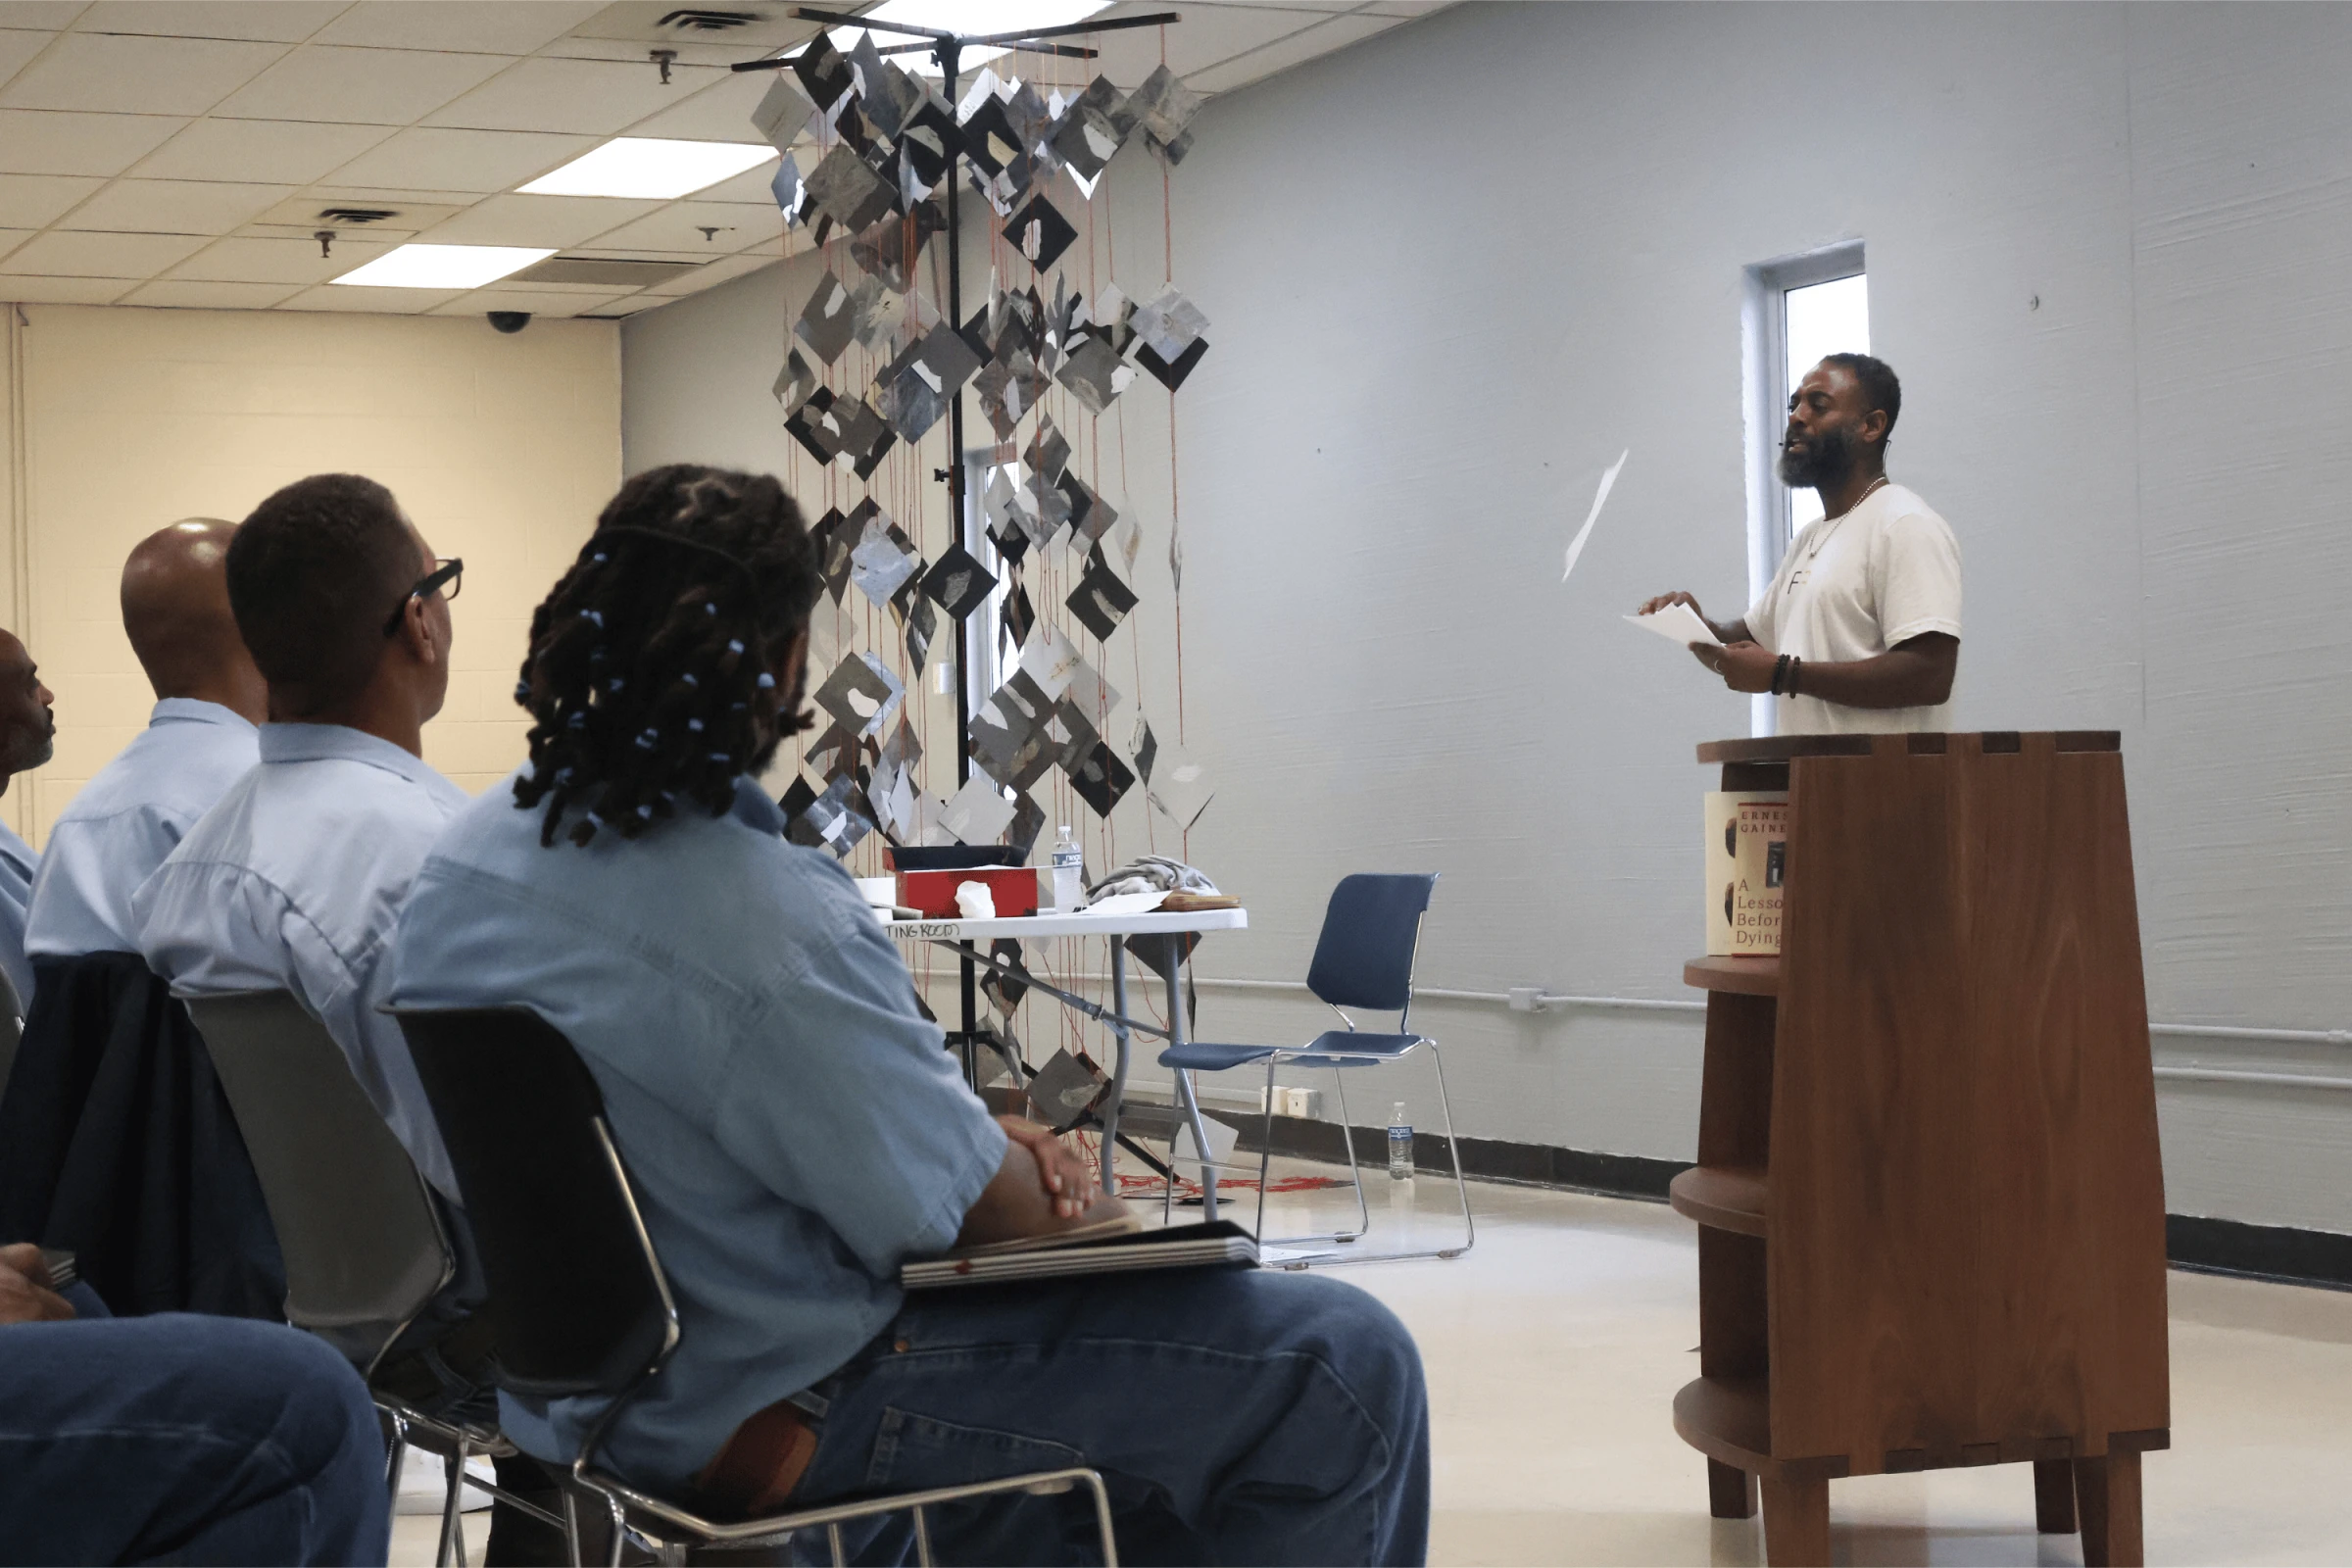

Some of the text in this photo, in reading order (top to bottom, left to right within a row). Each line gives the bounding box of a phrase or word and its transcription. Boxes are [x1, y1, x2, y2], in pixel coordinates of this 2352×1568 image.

[1741, 811, 1788, 820] ERNES
[1740, 824, 1787, 833] GAINE
[1738, 878, 1749, 892] A
[1738, 896, 1784, 909] Lesso
[1737, 912, 1782, 927] Befor
[884, 925, 918, 939] TING
[1736, 930, 1782, 948] Dying
